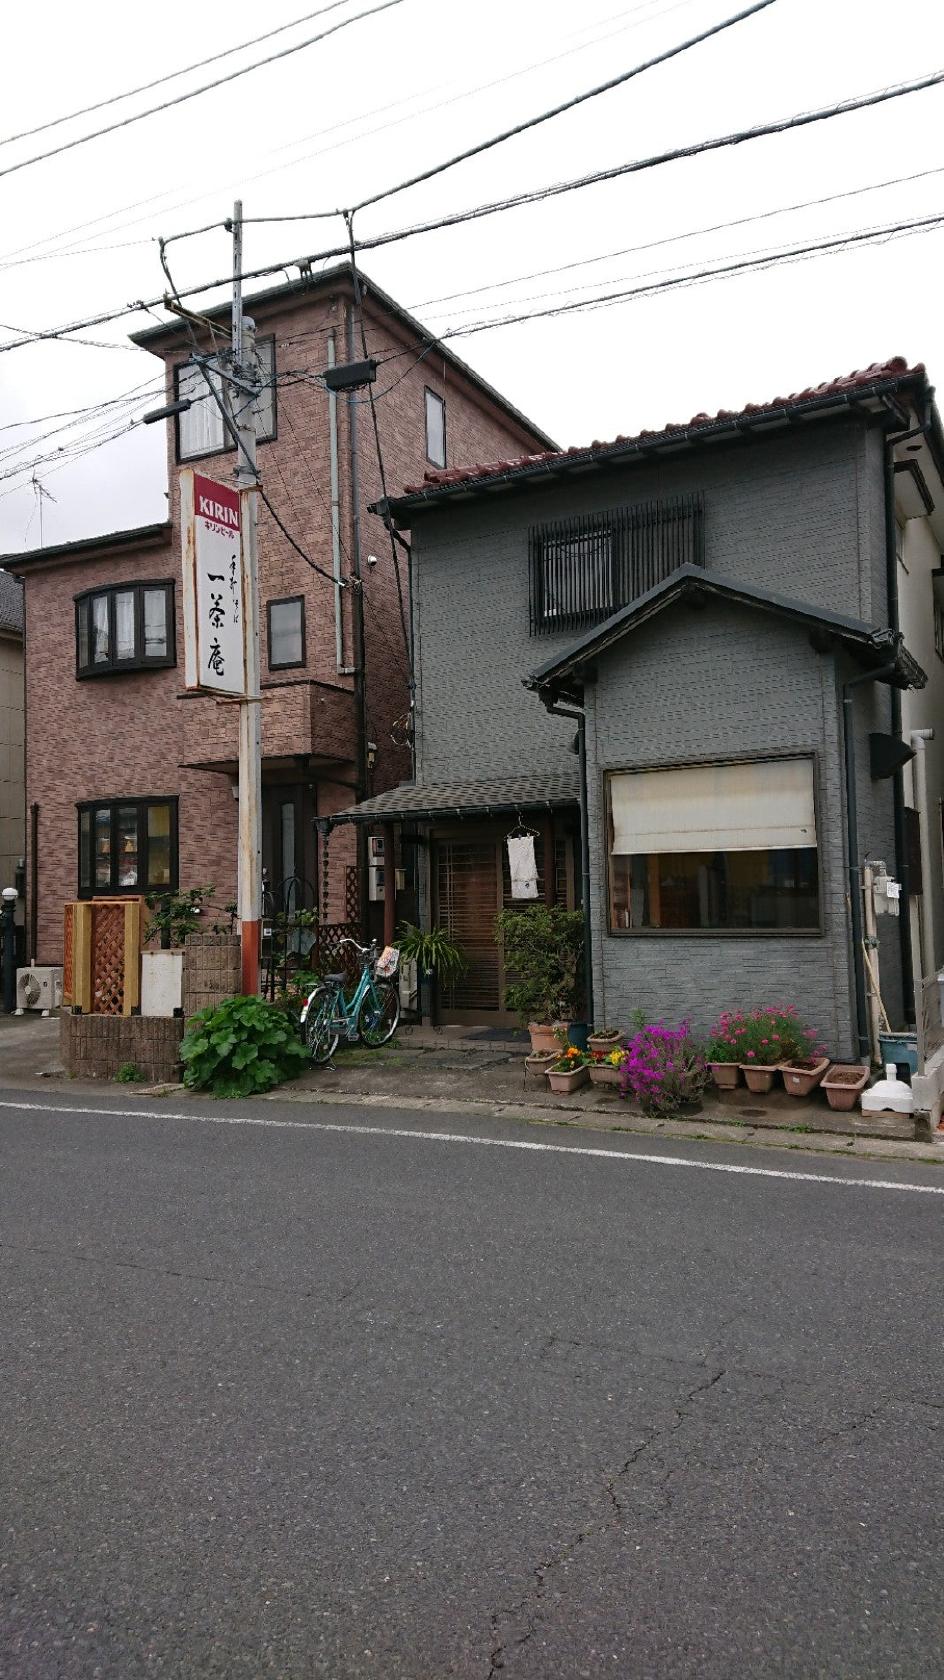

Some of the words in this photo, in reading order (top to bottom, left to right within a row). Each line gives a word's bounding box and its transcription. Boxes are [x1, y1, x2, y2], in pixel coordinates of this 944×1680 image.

[199, 495, 239, 528] KIRIN
[204, 520, 235, 539] キリンビール
[207, 572, 226, 677] 一茶庵
